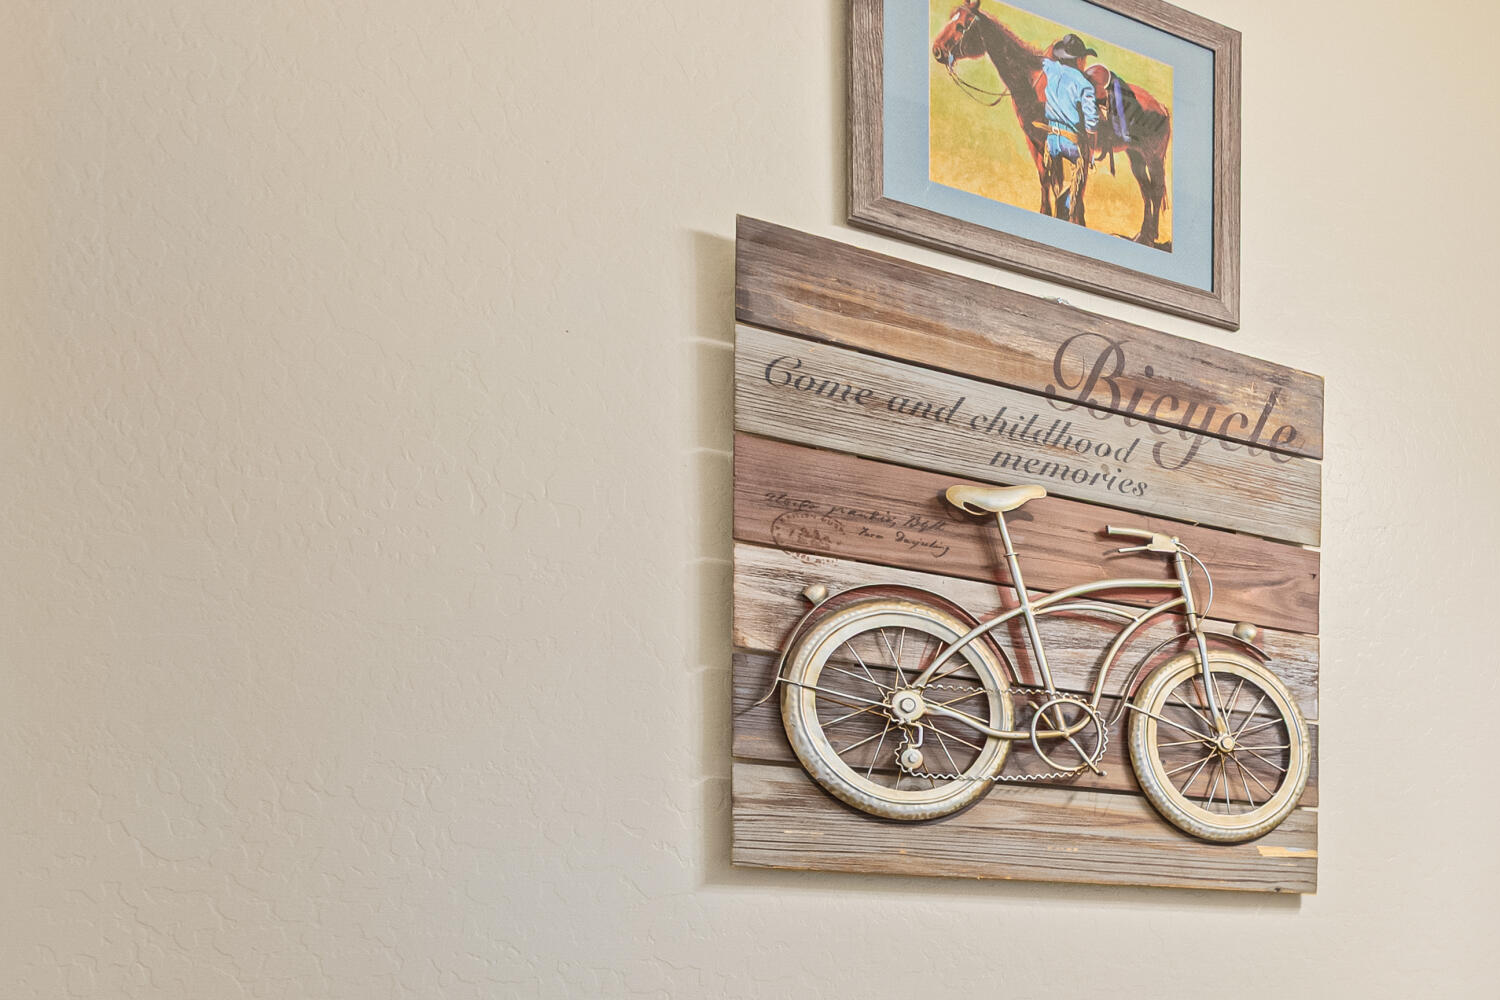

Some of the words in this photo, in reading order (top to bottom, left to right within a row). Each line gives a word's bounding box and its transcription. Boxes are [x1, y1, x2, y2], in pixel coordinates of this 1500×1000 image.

[886, 396, 967, 426] and
[968, 412, 1142, 464] childhood
[1045, 333, 1302, 470] Bicycle
[990, 448, 1150, 498] memories
